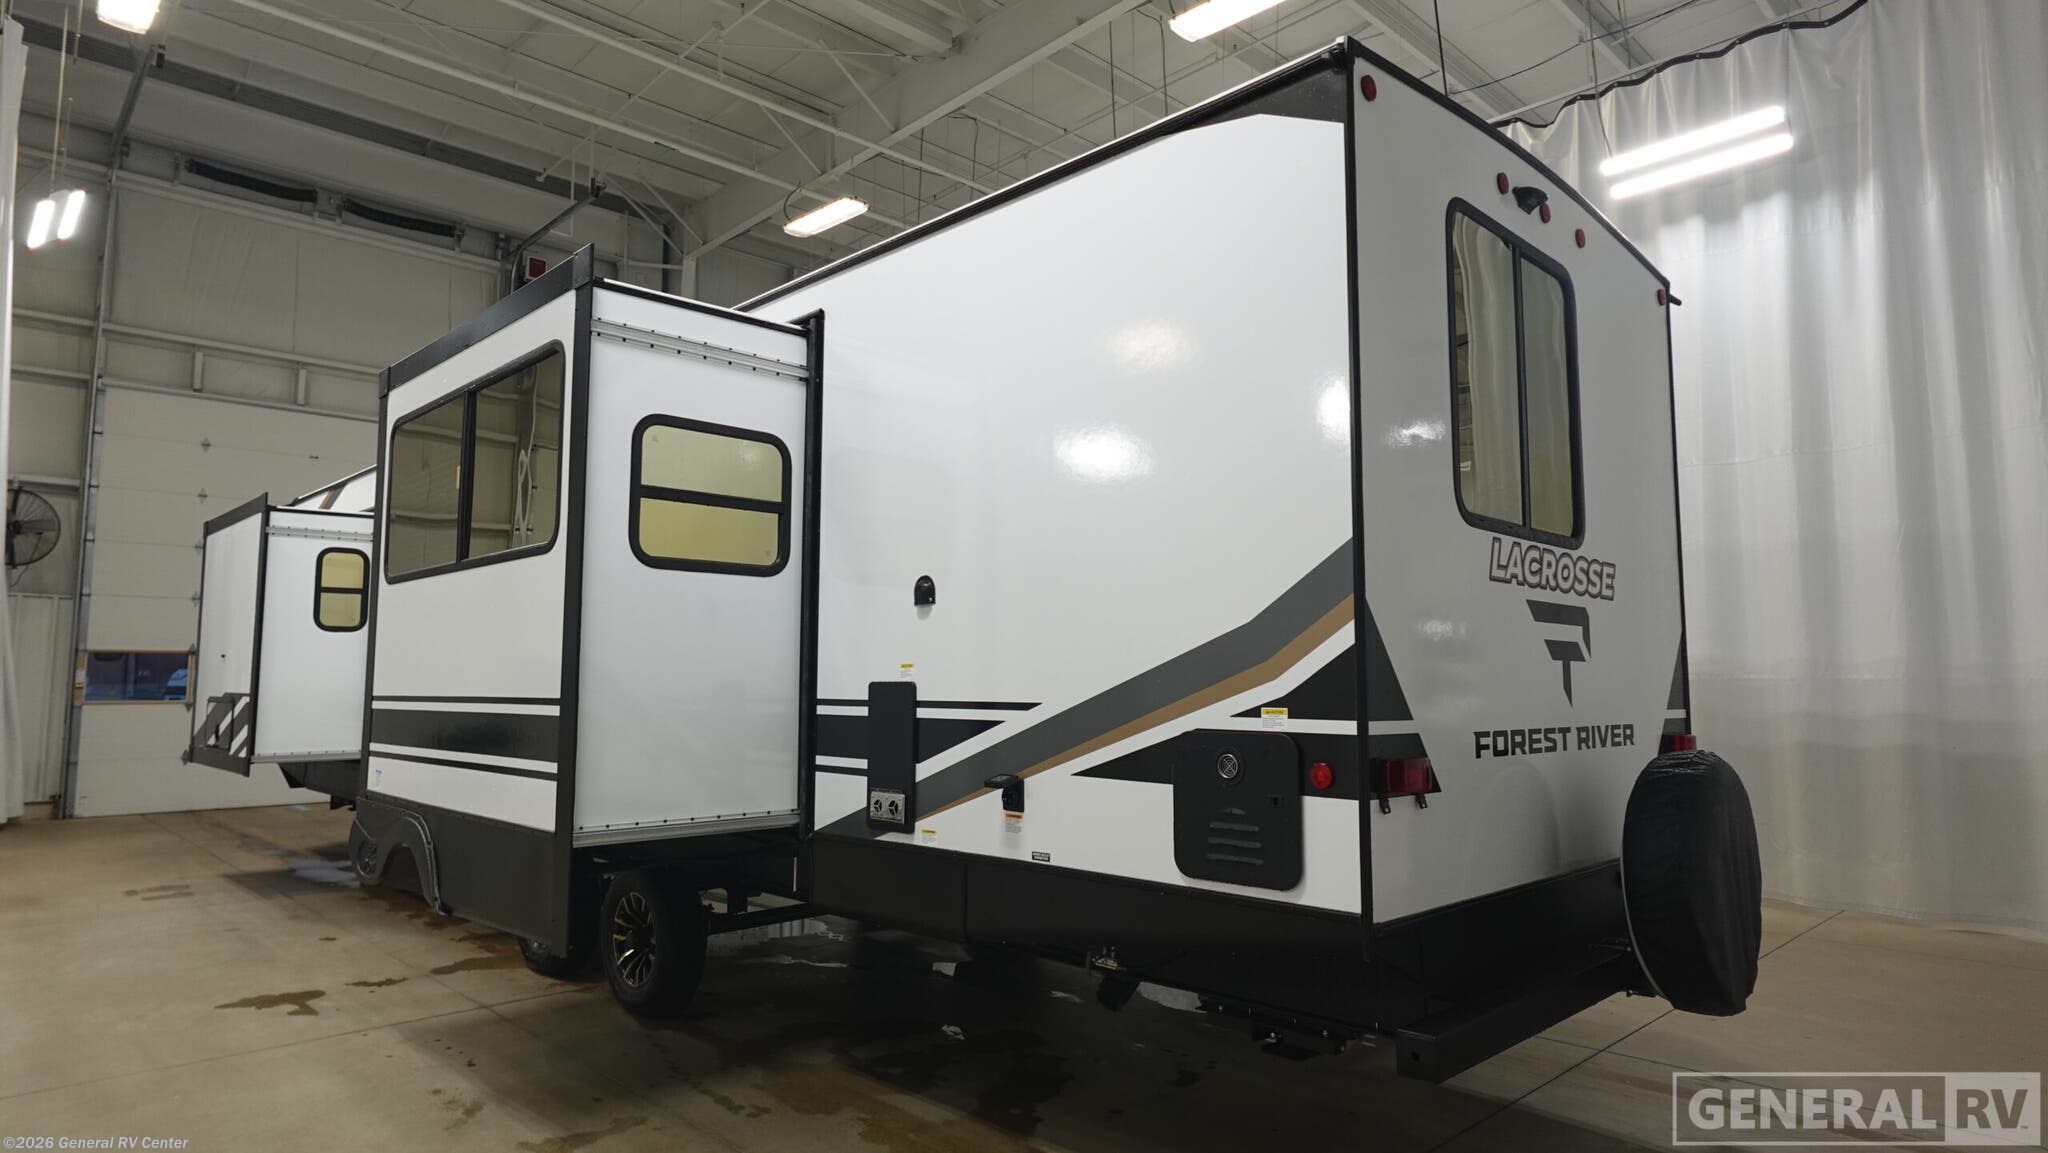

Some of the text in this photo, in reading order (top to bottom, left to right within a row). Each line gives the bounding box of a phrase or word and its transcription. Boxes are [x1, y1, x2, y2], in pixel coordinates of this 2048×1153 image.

[1489, 536, 1616, 601] LACROSSE
[1473, 724, 1635, 759] FOREST RIVER
